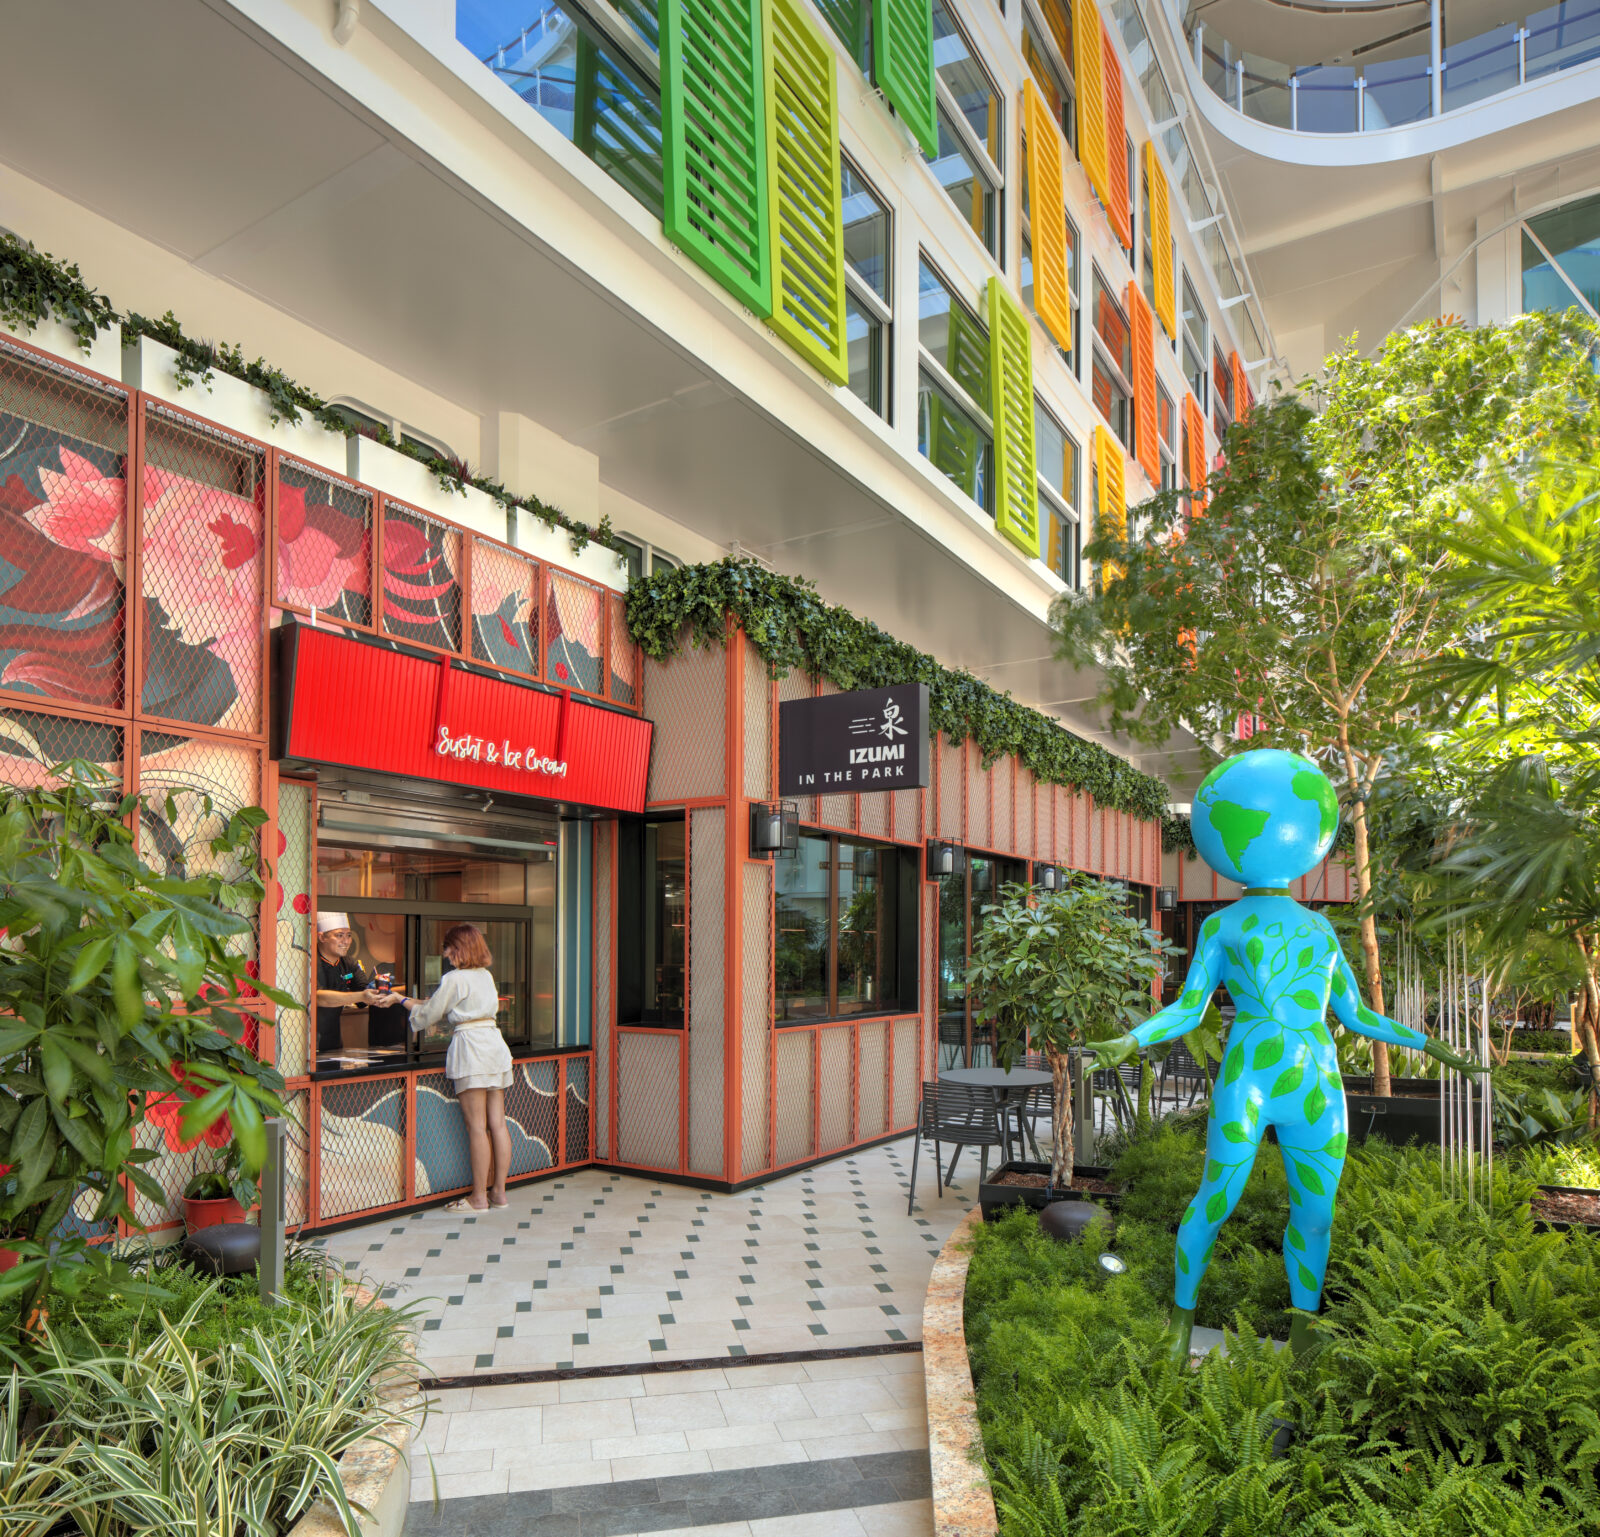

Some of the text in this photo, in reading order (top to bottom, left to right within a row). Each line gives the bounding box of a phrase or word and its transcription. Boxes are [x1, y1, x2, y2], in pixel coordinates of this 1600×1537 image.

[878, 697, 909, 740] 泉
[487, 743, 499, 763] &
[504, 740, 521, 769] Ice
[526, 748, 567, 777] Cream
[849, 744, 905, 764] IZUMI
[799, 765, 904, 785] IN THE PARK
